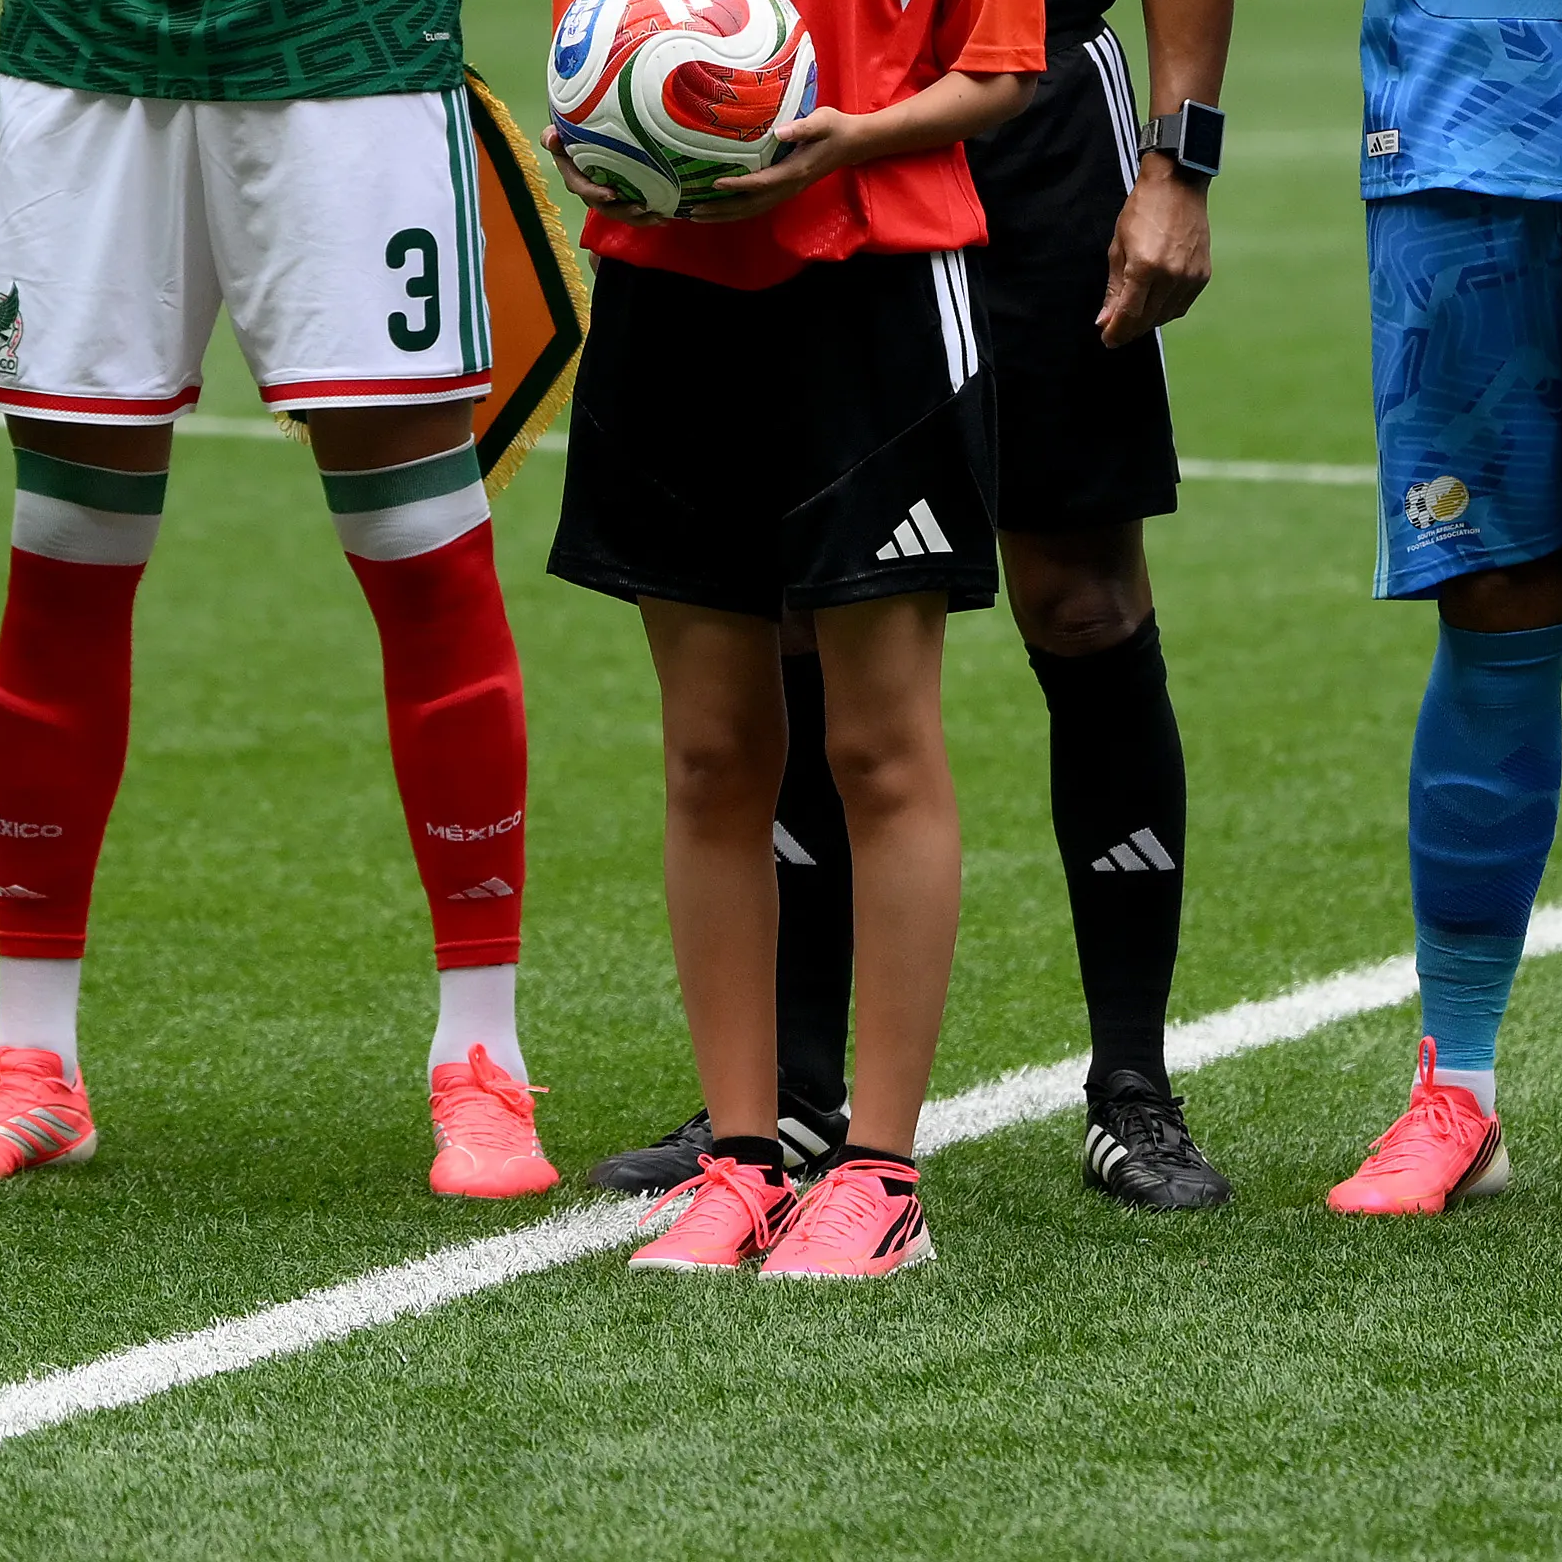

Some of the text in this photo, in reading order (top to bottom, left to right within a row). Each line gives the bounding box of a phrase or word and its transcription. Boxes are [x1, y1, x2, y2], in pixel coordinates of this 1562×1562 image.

[385, 227, 441, 353] 3
[1417, 522, 1466, 541] SOUTH AFRICAN
[1435, 527, 1481, 543] ASSOCIATION
[426, 809, 523, 842] MÉXICO
